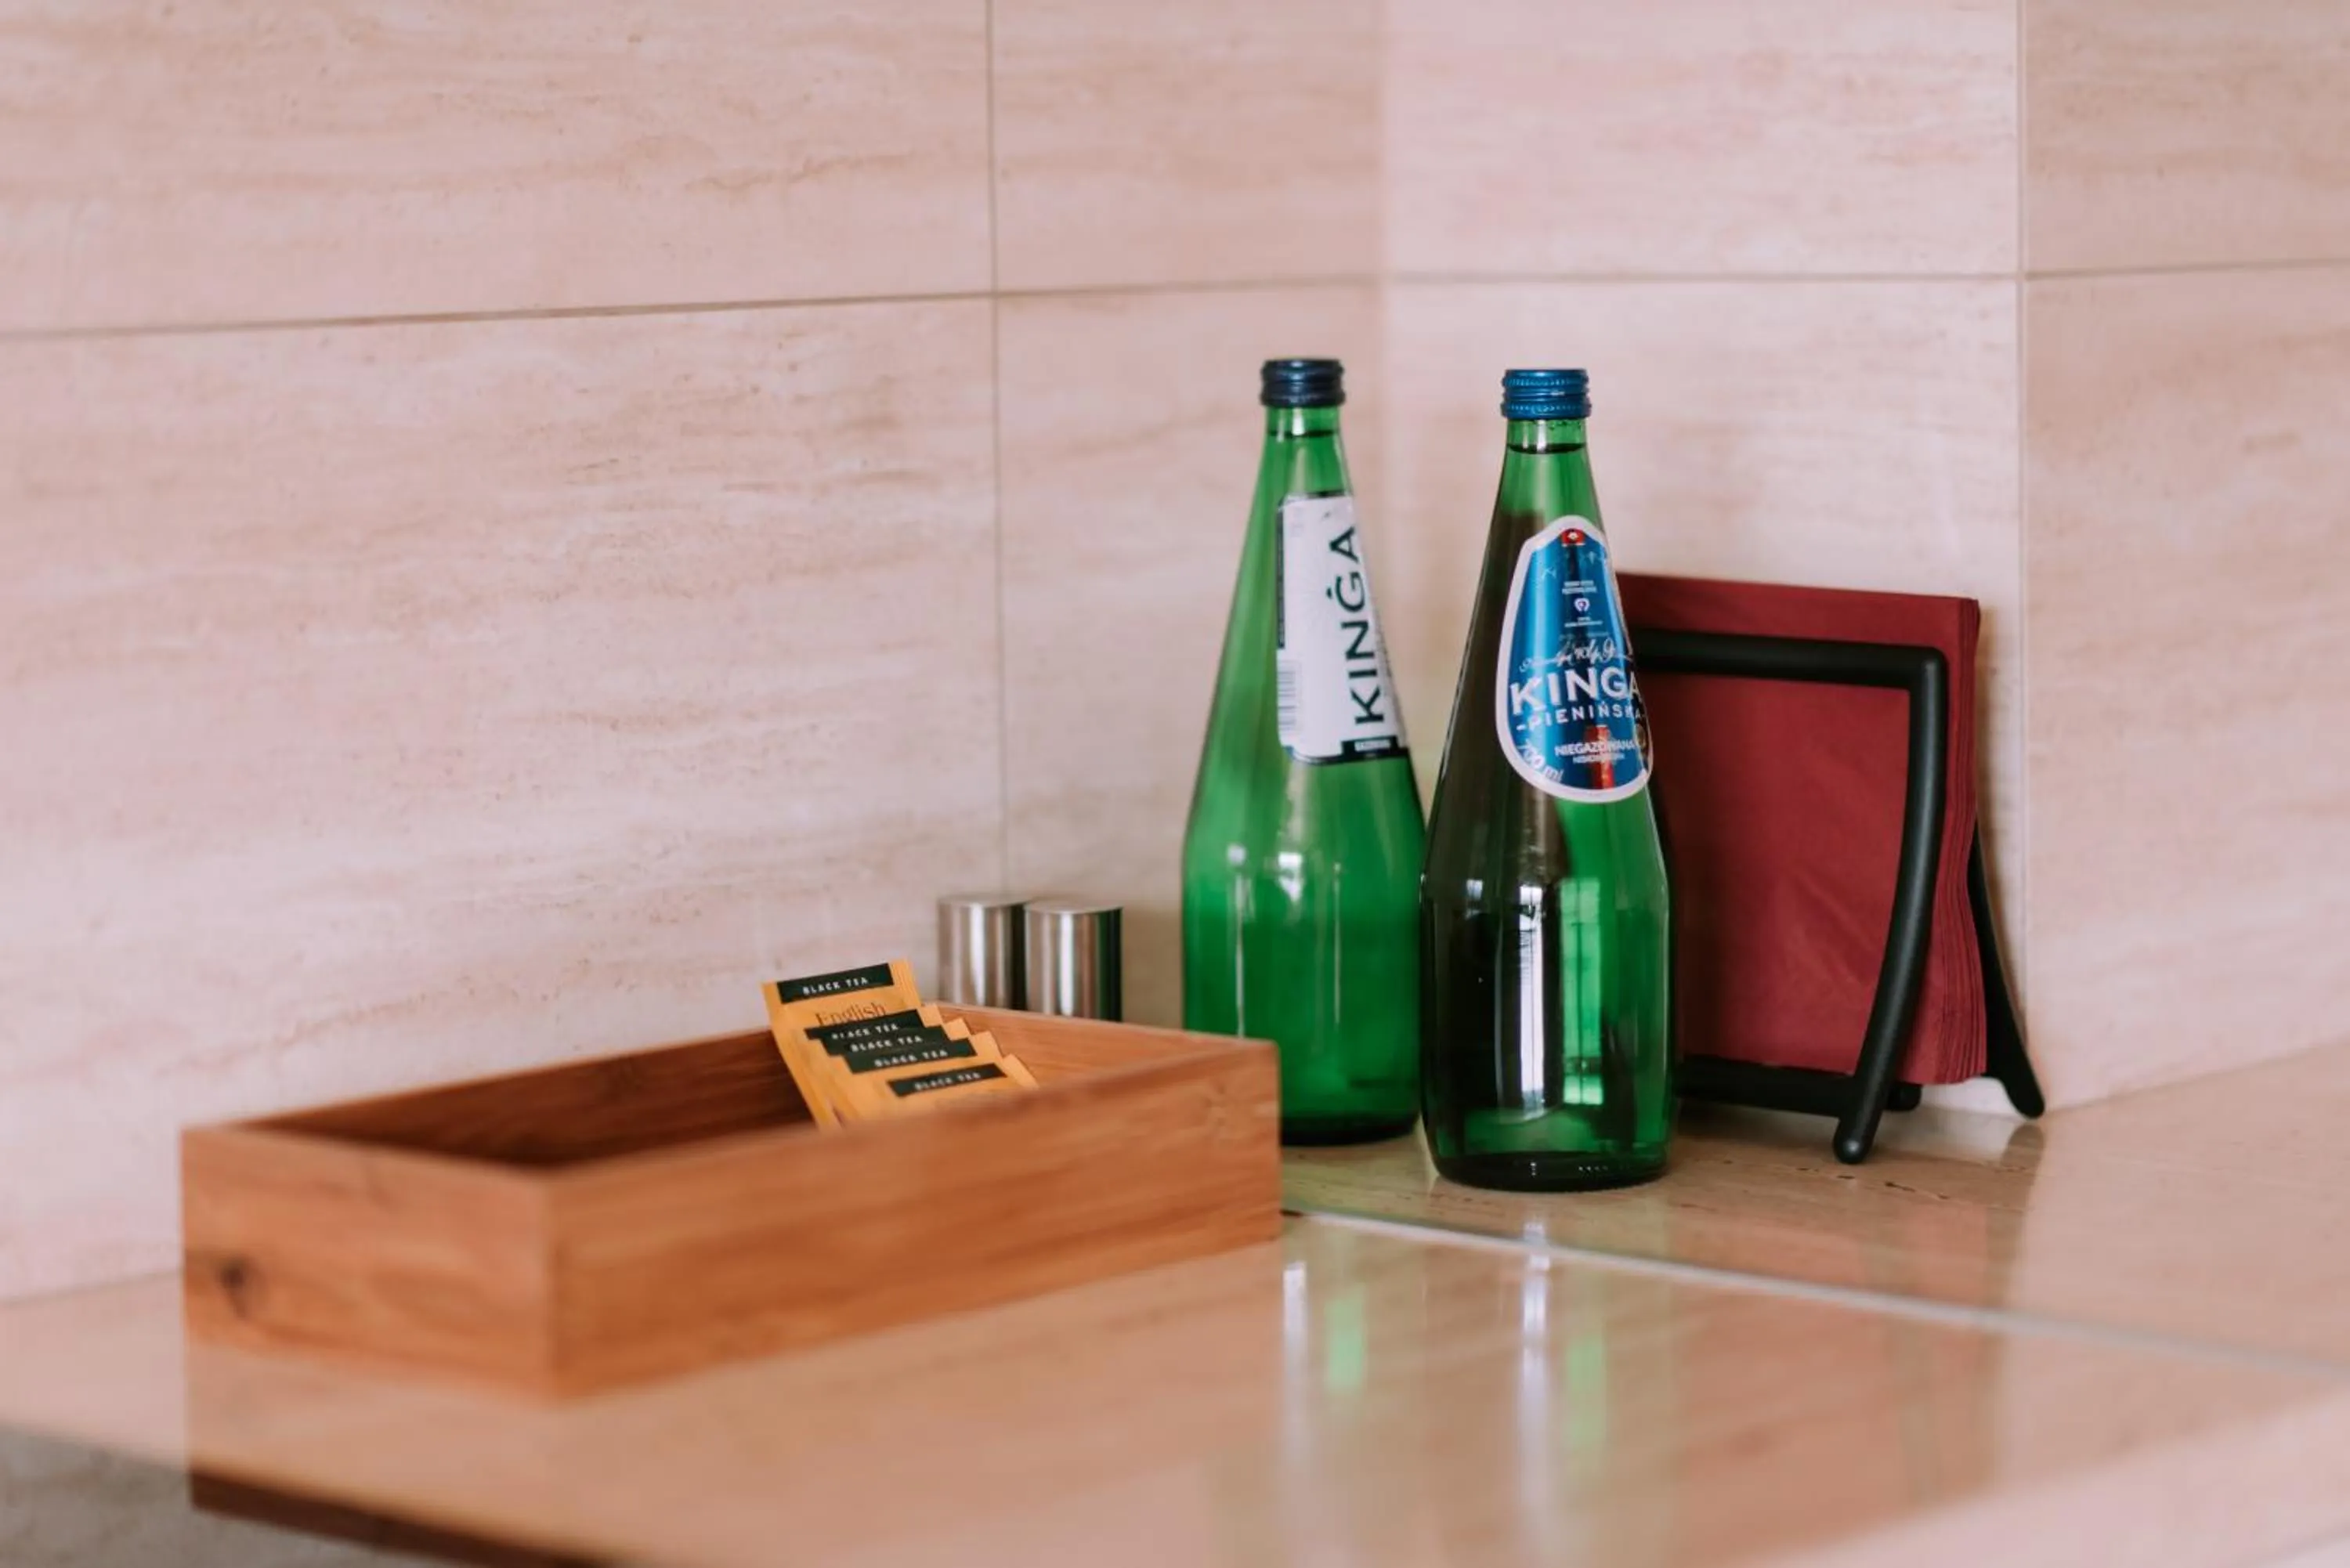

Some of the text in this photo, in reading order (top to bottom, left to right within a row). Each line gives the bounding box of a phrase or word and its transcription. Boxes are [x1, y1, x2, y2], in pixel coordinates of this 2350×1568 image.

[1509, 667, 1643, 716] KINGA
[802, 977, 870, 995] BLACK TEA
[815, 1001, 887, 1026] English
[831, 1022, 899, 1040] BLACK TEA
[850, 1035, 924, 1053] BLACK TEA
[874, 1049, 949, 1067] BLACK TEA
[913, 1071, 982, 1090] BLACK TEA
